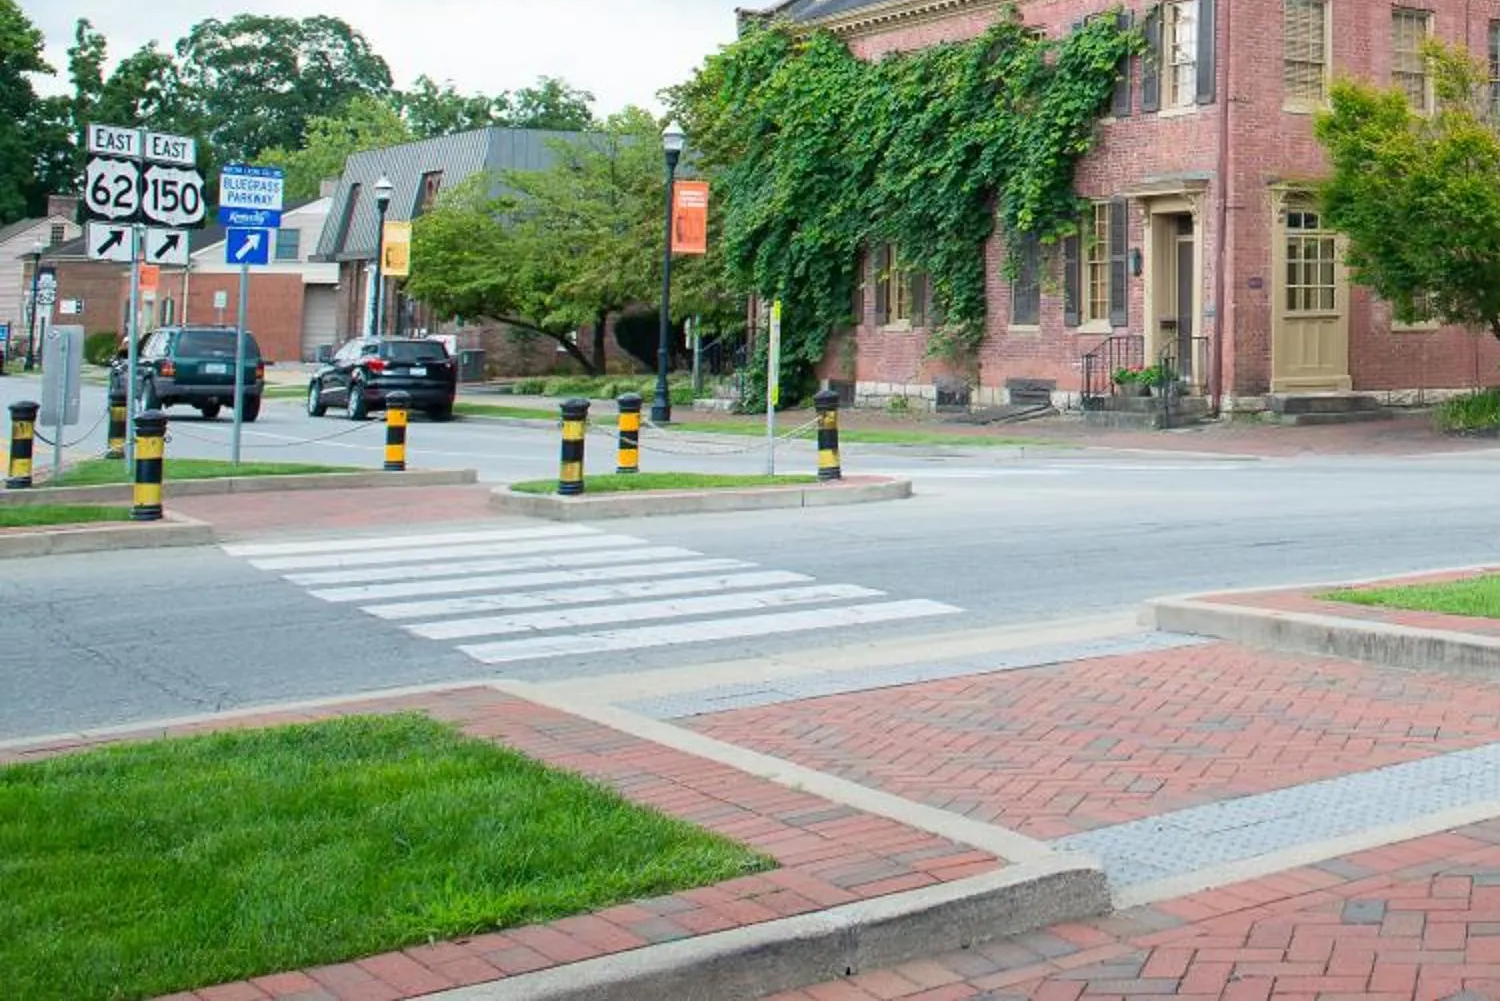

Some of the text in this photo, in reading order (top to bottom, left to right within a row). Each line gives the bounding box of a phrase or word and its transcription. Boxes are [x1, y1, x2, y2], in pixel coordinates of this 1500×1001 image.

[96, 128, 132, 151] EAST
[153, 136, 186, 159] EAST
[91, 172, 133, 208] 62
[151, 178, 199, 215] 150
[223, 177, 280, 194] BLUEGRASS
[227, 191, 273, 205] PARKWAY
